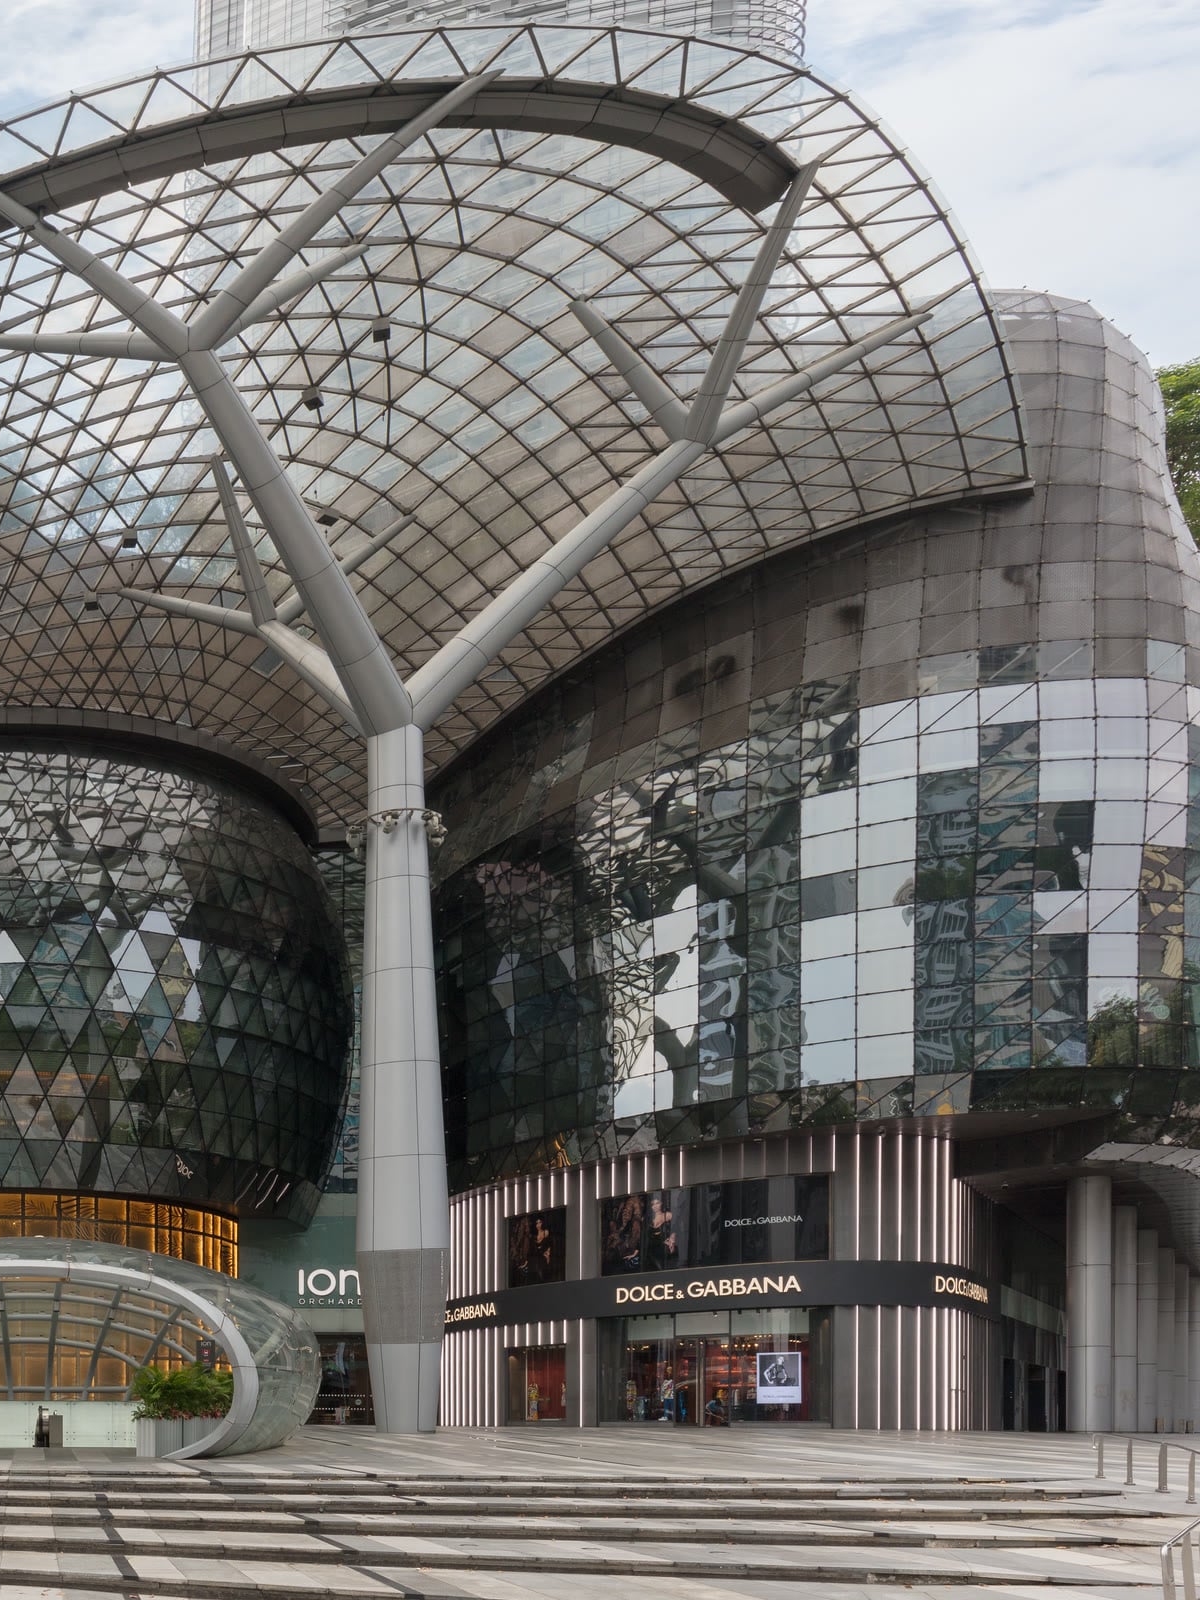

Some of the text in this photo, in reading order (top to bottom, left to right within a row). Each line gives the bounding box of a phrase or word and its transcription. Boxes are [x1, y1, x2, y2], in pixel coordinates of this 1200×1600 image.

[724, 1218, 752, 1228] DOLCE
[756, 1215, 804, 1225] GABBANA
[616, 1275, 802, 1304] DOLCE & GABBANA
[935, 1275, 967, 1296] DOLCE
[453, 1302, 497, 1321] GABBANA
